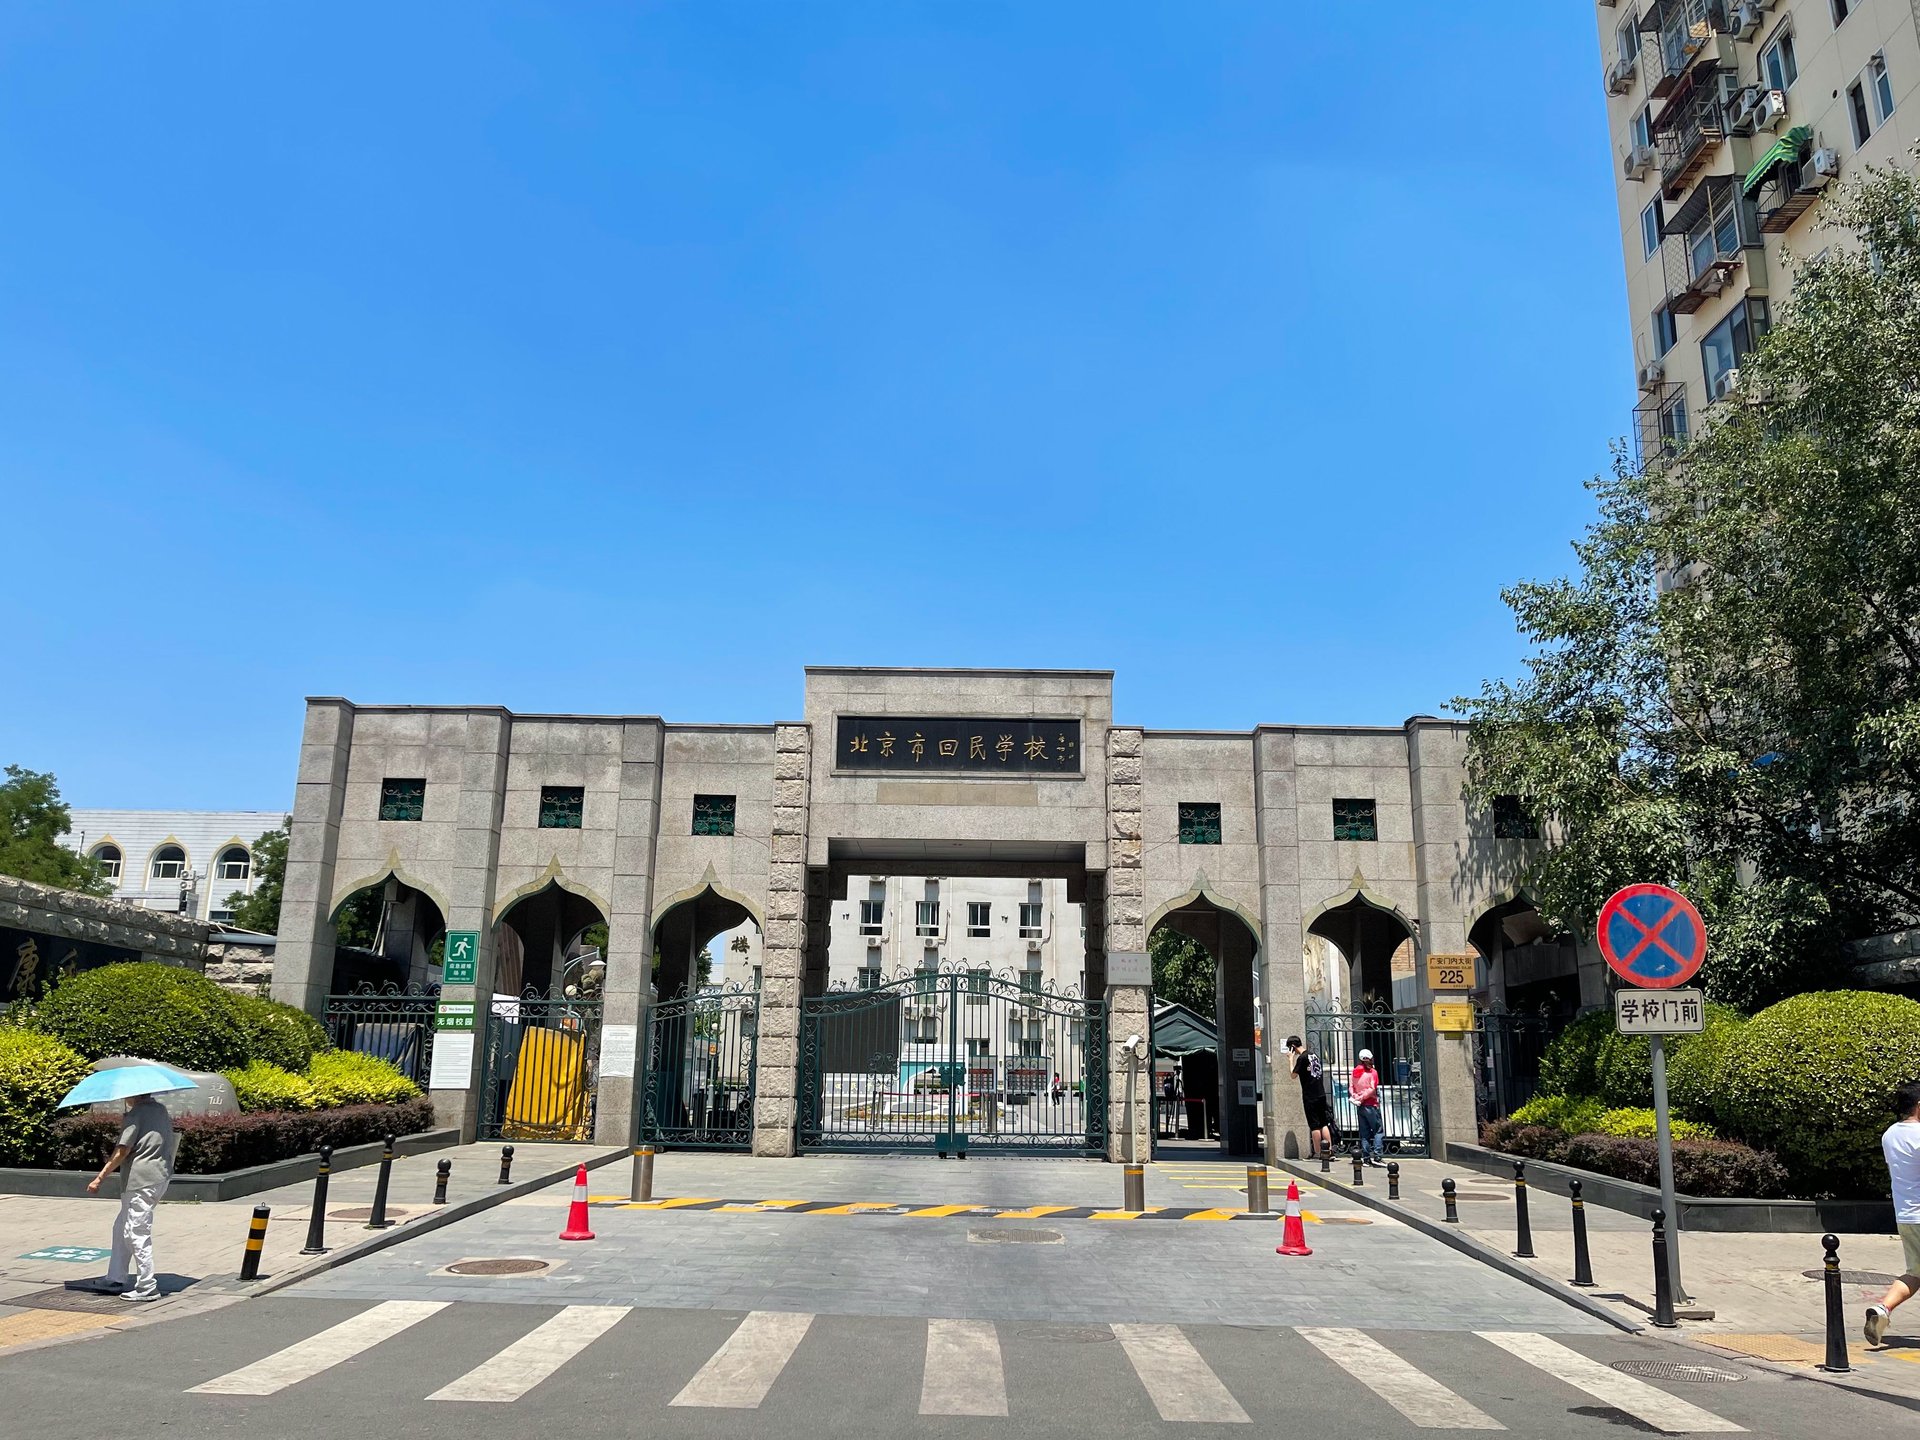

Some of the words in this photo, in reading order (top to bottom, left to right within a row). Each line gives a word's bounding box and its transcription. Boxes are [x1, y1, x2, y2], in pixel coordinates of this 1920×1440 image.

[850, 731, 1049, 762] 北京市回民学校
[1430, 957, 1472, 965] 广安门内大街
[1440, 970, 1464, 984] 225
[1621, 998, 1698, 1025] 学校门前
[437, 1017, 473, 1026] 无烟校园
